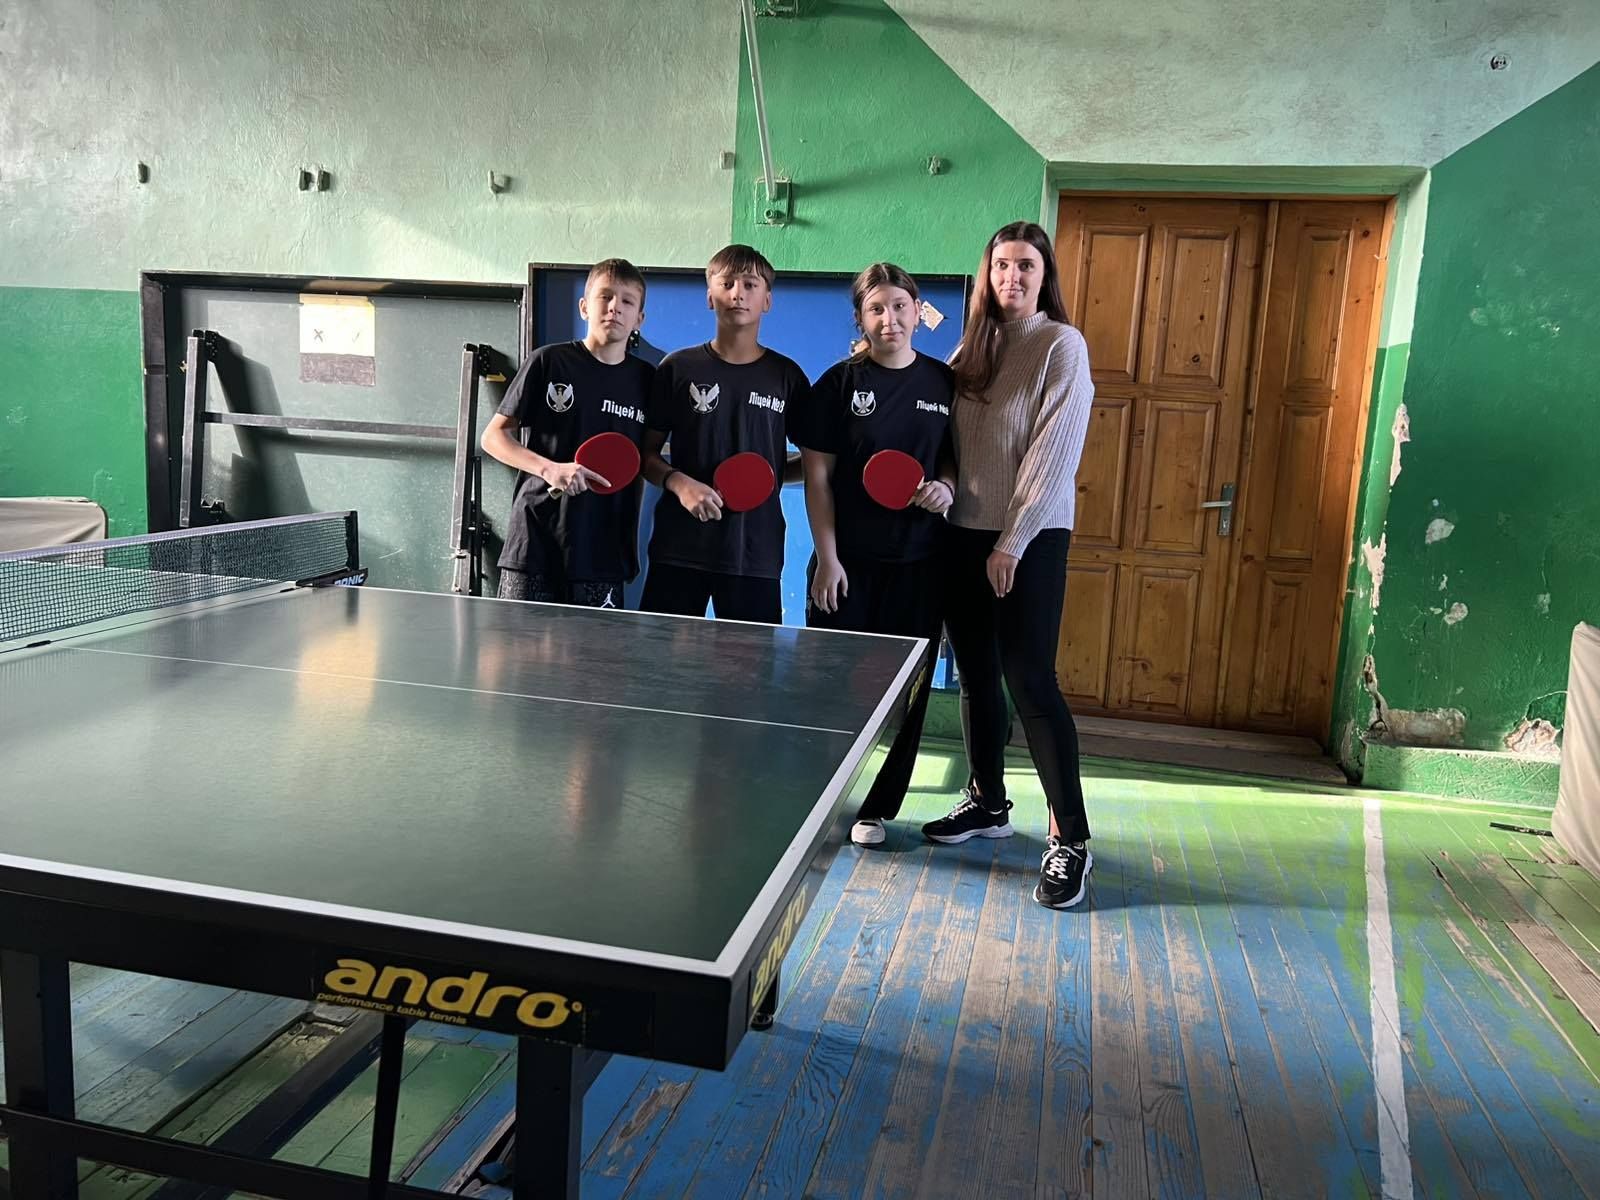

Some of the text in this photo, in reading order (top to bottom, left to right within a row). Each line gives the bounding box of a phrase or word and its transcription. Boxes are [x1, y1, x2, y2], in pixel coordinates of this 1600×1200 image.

[601, 399, 635, 419] Ліцей
[749, 391, 771, 408] Ліцей
[324, 958, 570, 1028] andro
[316, 992, 467, 1025] performance table tennis
